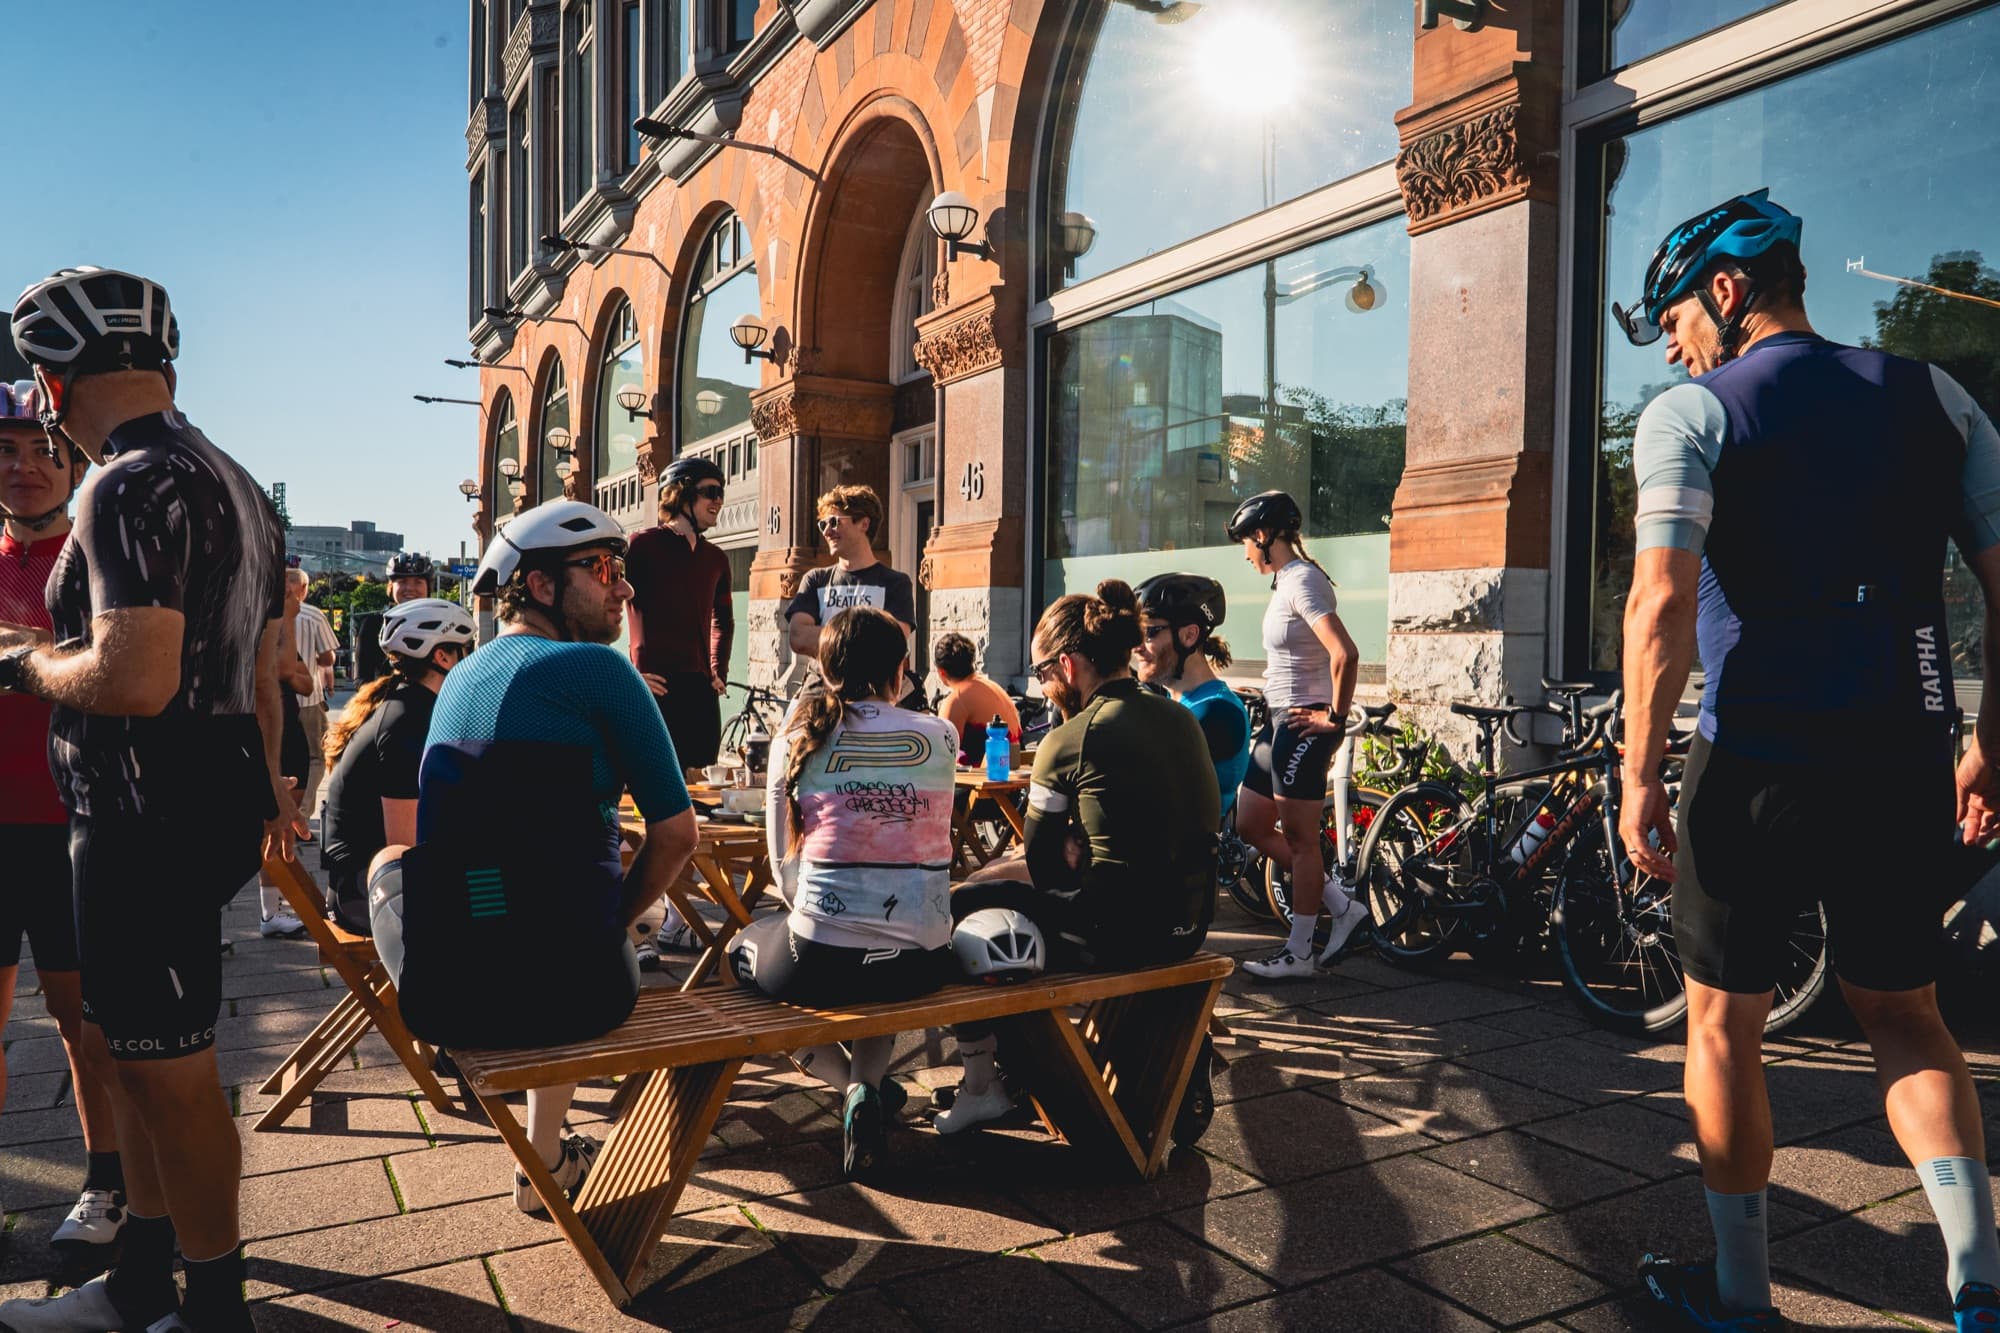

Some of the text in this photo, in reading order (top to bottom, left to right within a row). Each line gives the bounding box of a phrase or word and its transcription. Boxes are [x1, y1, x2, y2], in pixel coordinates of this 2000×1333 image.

[960, 461, 984, 501] 46
[767, 505, 781, 535] 46
[1915, 625, 1945, 711] RAPHA
[1283, 734, 1319, 785] CANADA
[126, 1038, 165, 1051] COL
[179, 1032, 201, 1048] LE
